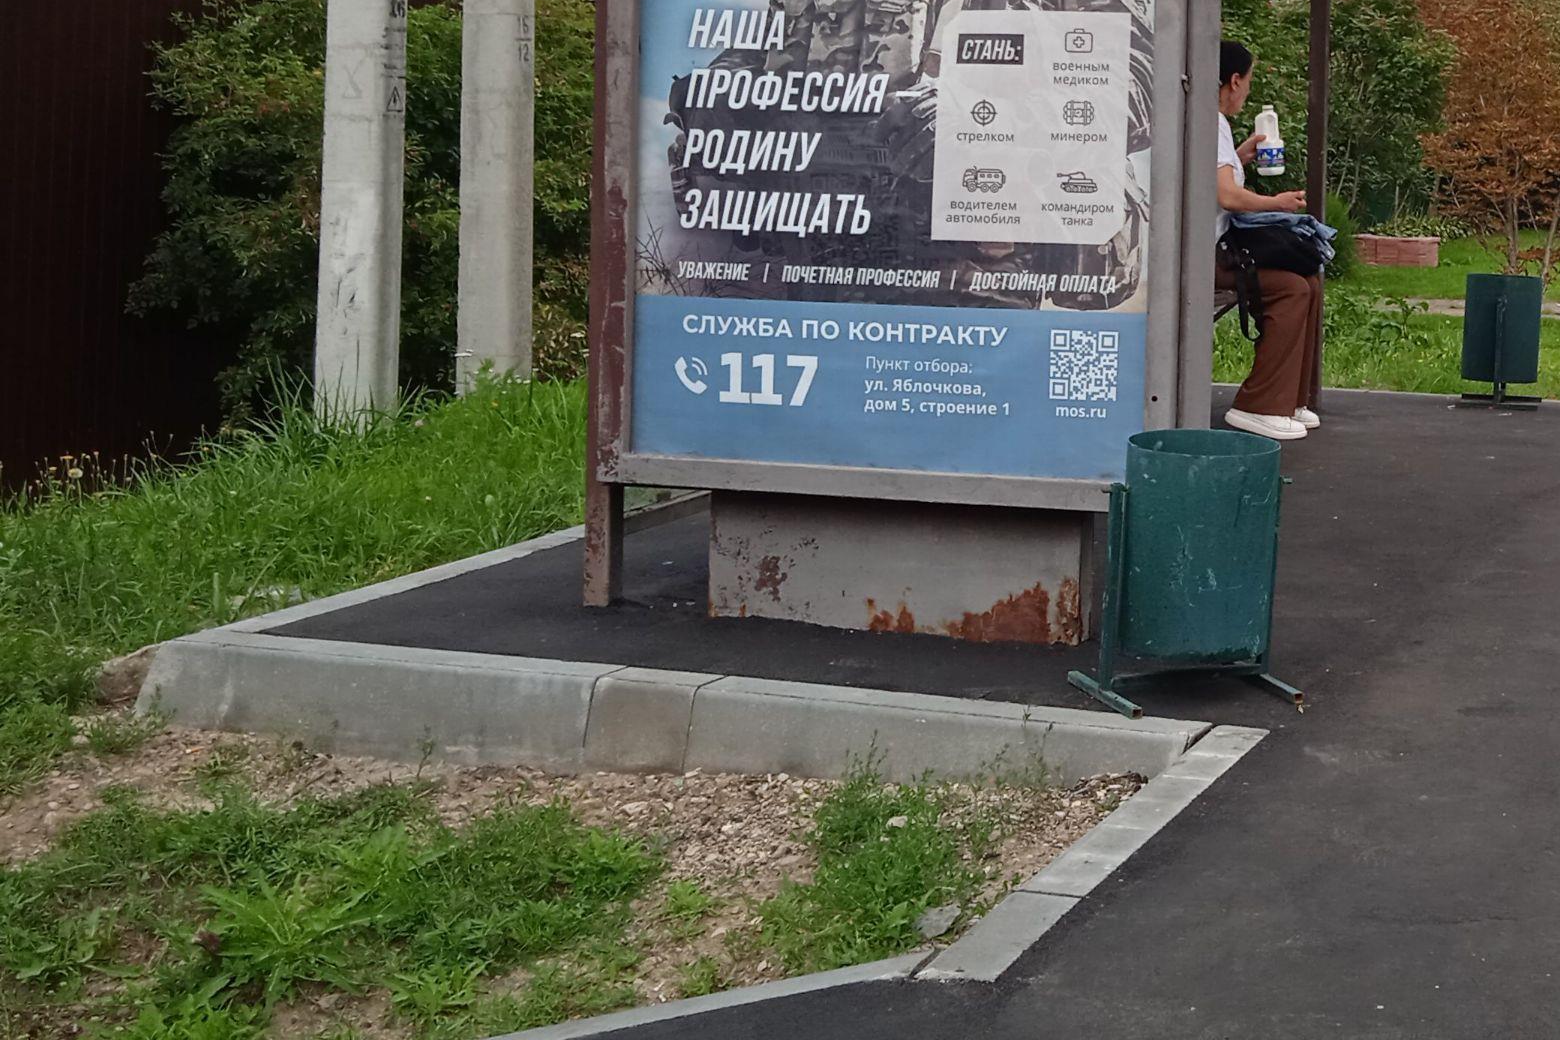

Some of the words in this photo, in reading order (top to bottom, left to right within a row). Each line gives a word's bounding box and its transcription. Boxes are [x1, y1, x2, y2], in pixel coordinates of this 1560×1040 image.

[688, 9, 785, 50] НАША
[961, 38, 1022, 61] СТАНЬ:
[1052, 62, 1110, 72] военным
[1053, 75, 1109, 86] медиком
[685, 68, 890, 113] ПРОФЕССИЯ
[956, 133, 1014, 144] стрелком
[1050, 133, 1108, 144] минером
[682, 128, 822, 175] РОДИНУ
[679, 188, 871, 238] ЗАЩИЩАТЬ
[950, 201, 1017, 212] водителем
[1041, 203, 1114, 215] командиром
[945, 213, 1021, 226] автомобиля
[1061, 217, 1093, 226] танка
[677, 260, 751, 281] УВАЖЕНИЕ
[781, 265, 853, 285] ПОЧЕТНАЯ
[856, 267, 941, 289] ПРОФЕССИЯ
[969, 270, 1056, 293] ДОСТОЙНАЯ
[1059, 274, 1117, 294] ОПЛАТА
[682, 314, 793, 338] СЛУЖБА
[802, 320, 840, 340] ПО
[848, 321, 1008, 346] КОНТРАКТУ
[866, 356, 910, 372] Пункт
[914, 357, 973, 375] отбора:
[719, 352, 818, 407] 117
[864, 379, 888, 394] ул.
[893, 379, 986, 397] Яблочкова,
[864, 400, 897, 413] дом
[901, 398, 915, 414] 5,
[919, 402, 997, 416] строение
[1002, 403, 1010, 415] 1
[1055, 406, 1106, 418] mos.ru
